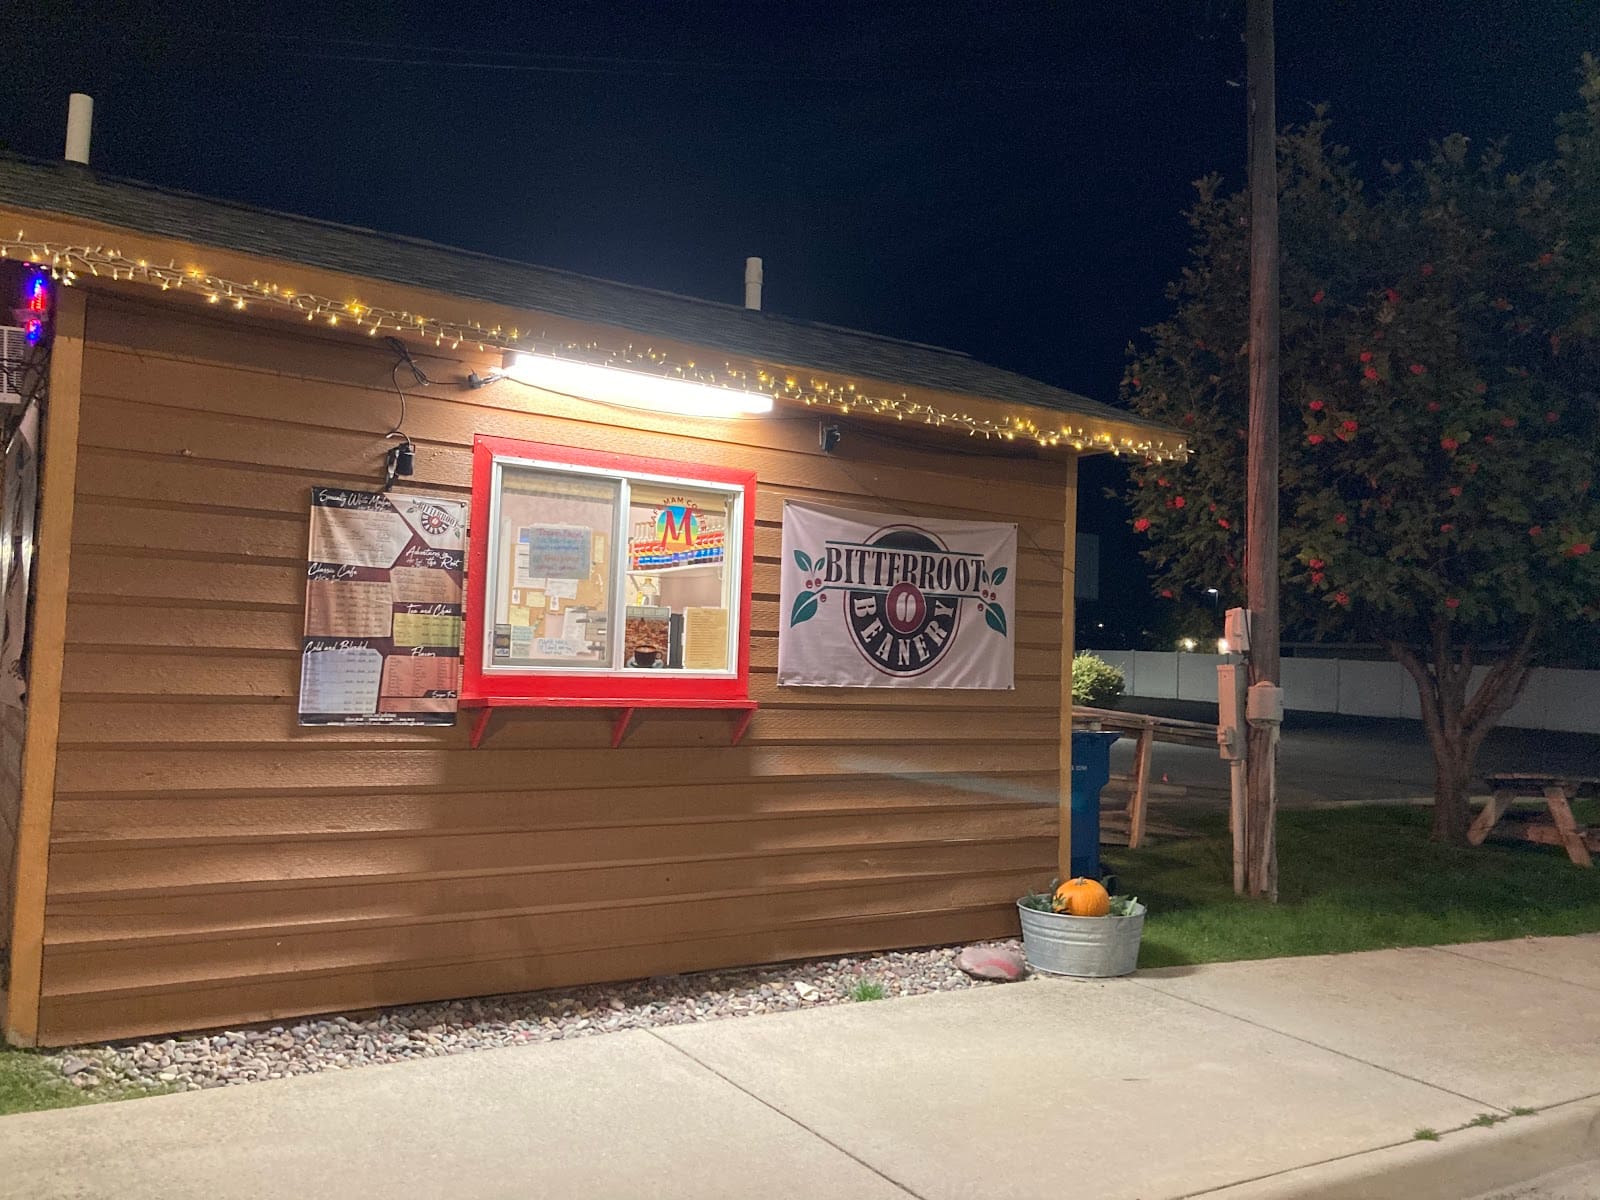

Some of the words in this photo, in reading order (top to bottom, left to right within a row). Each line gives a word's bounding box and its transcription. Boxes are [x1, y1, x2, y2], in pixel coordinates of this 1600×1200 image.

[663, 496, 684, 504] MAM
[823, 546, 985, 592] BITTERROOT
[854, 596, 956, 666] BEANERY
